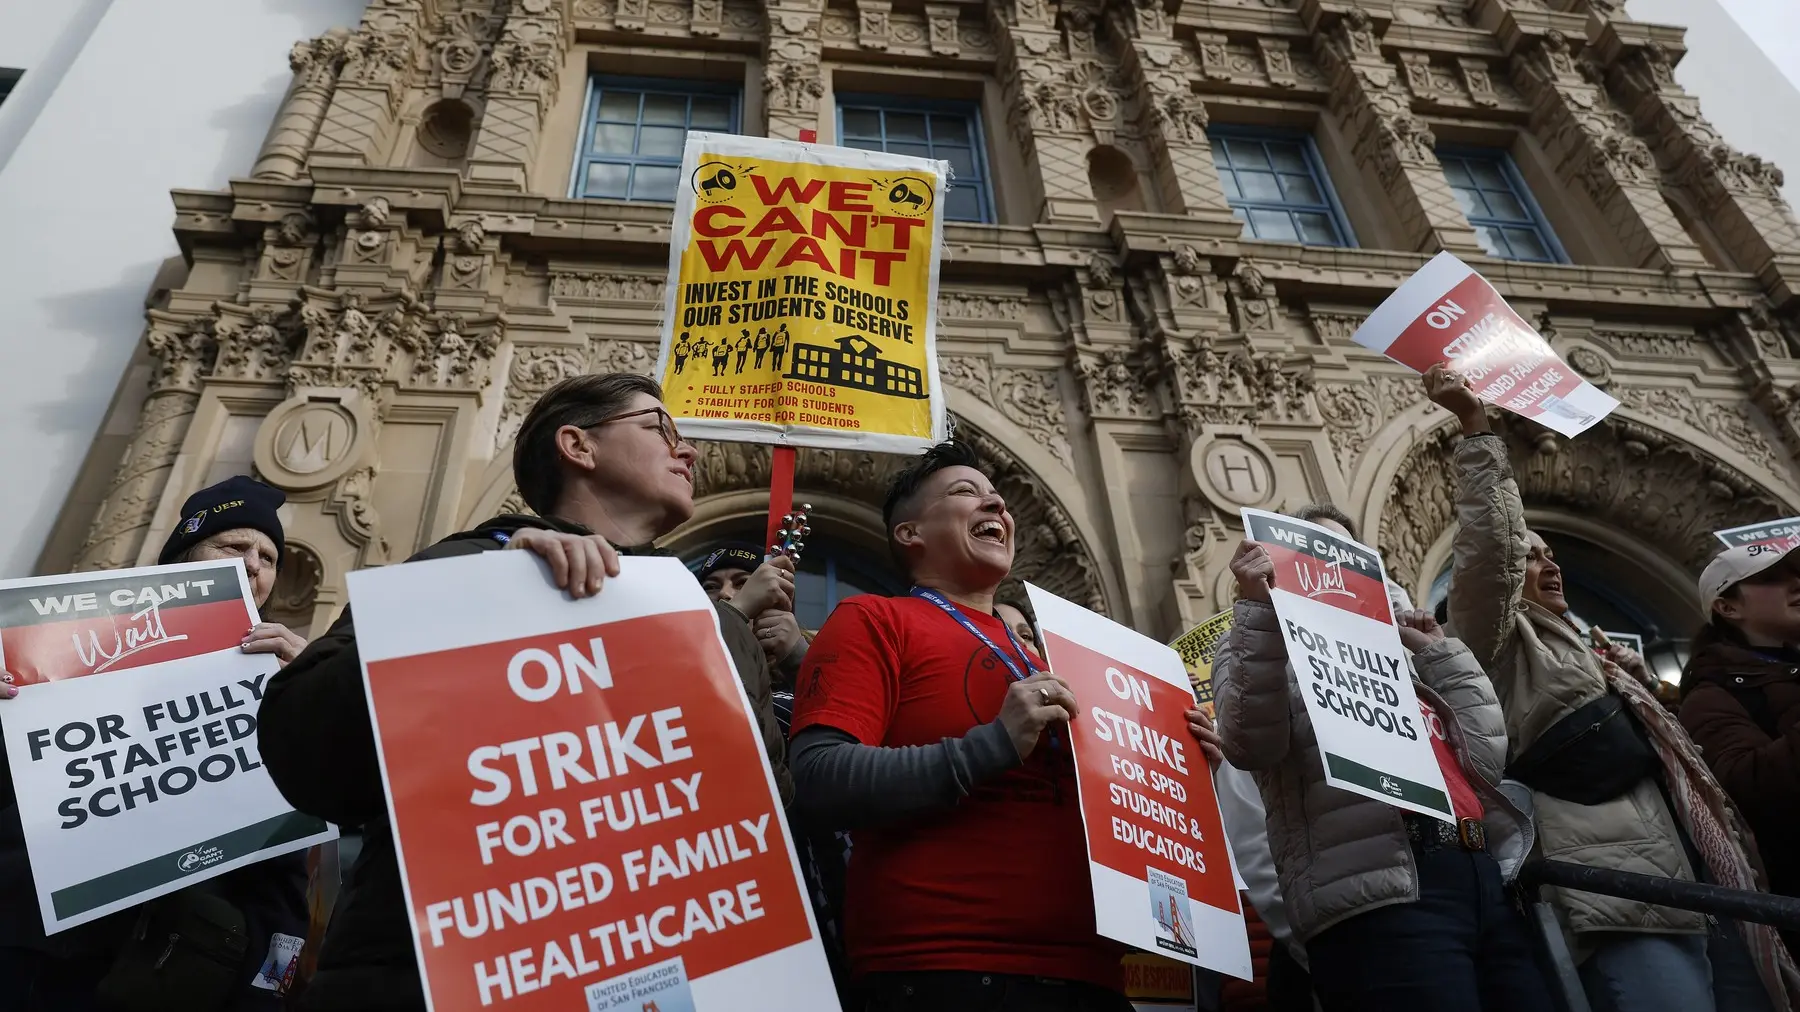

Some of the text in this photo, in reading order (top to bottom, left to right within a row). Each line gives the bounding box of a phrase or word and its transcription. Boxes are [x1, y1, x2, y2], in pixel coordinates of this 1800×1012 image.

[749, 174, 874, 212] WE
[693, 206, 925, 250] CAN'T
[696, 236, 906, 287] WAIT
[683, 298, 914, 344] OUR STUDENTS DESERVE
[684, 275, 909, 321] INVEST IN THE SCHOOLS
[1426, 299, 1467, 330] ON
[697, 395, 854, 415] STABILITY FOR OUR STUDENTS
[703, 381, 836, 397] FULLY STAFFED SCHOOLS
[1476, 374, 1516, 402] UNDED
[285, 420, 332, 461] M
[695, 408, 860, 428] LIVING WAGES FOR EDUCATORS
[1219, 455, 1259, 493] H
[213, 499, 246, 514] UESF
[729, 549, 757, 561] UESF
[1269, 526, 1368, 571] WE CAN'T
[1736, 530, 1768, 541] WE
[1295, 553, 1350, 594] Wait
[29, 579, 215, 616] WE CAN'T
[72, 593, 187, 668] Wait
[1285, 618, 1400, 681] FOR FULLY
[507, 637, 613, 703] ON
[1105, 666, 1154, 712] ON
[1308, 655, 1400, 707] STAFFED
[27, 673, 266, 761] FOR FULLY
[1312, 682, 1417, 741] SCHOOLS
[65, 713, 257, 788] STAFFED
[467, 705, 694, 807] STRIKE
[1092, 706, 1189, 776] STRIKE
[57, 746, 264, 829] SCHOOL
[1110, 754, 1187, 803] FOR SPED
[475, 772, 703, 865] FOR FULLY
[1109, 783, 1204, 842] STUDENTS &
[202, 846, 218, 854] WE
[202, 855, 224, 866] WAIT
[1112, 815, 1206, 874] EDUCATORS
[425, 813, 770, 948] FUNDED FAMILY
[473, 879, 766, 1006] HEALTHCARE
[592, 964, 679, 1000] UNITED EDUCATORS
[610, 993, 630, 1007] SAN
[631, 977, 680, 999] FRANCISCO
